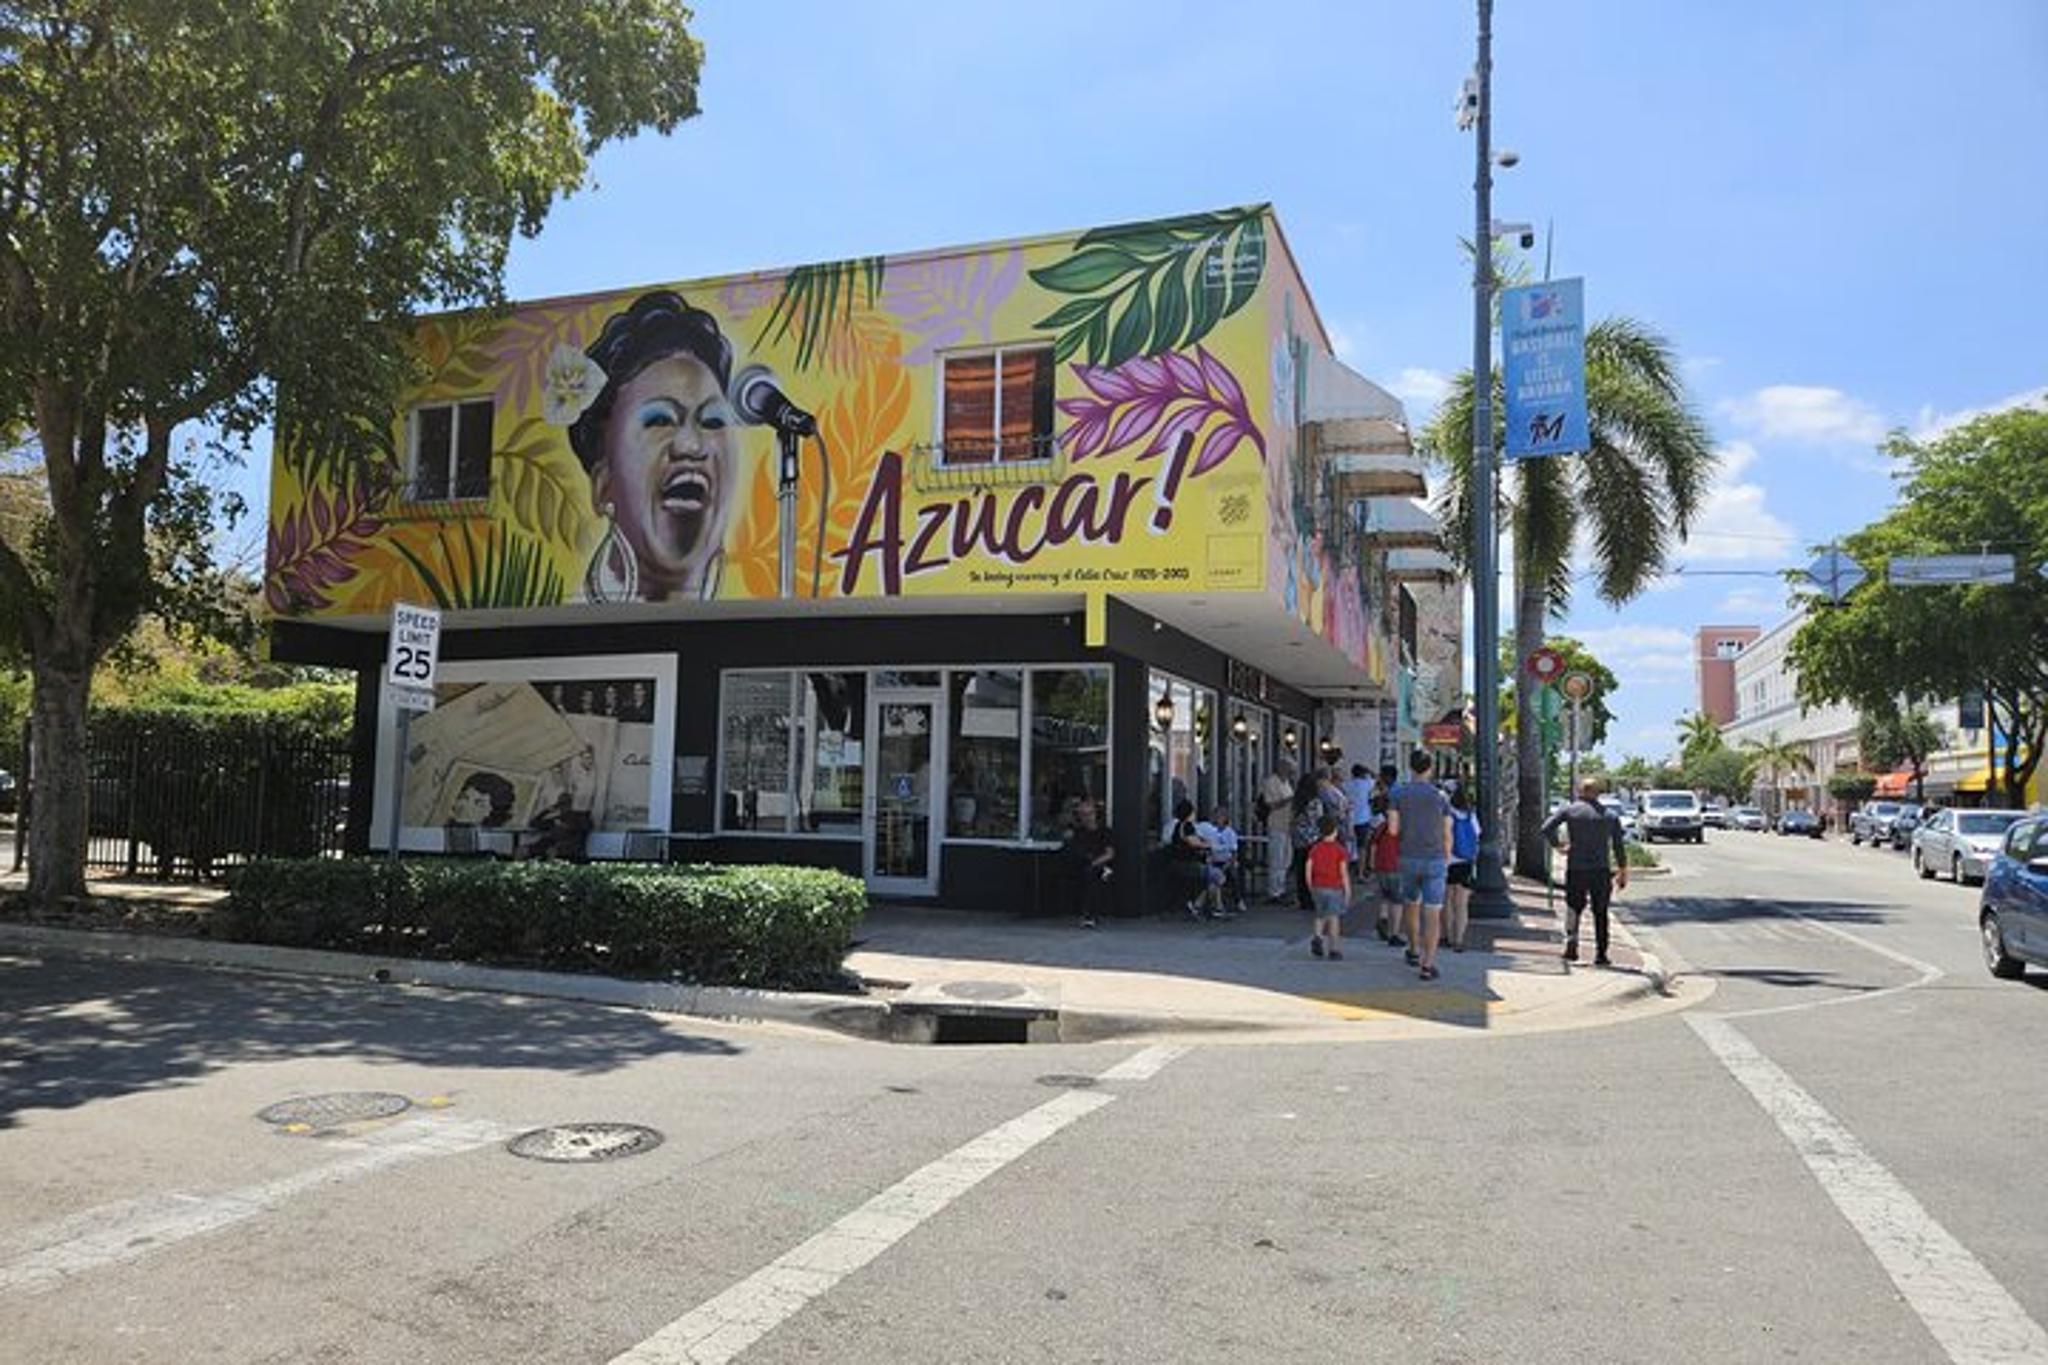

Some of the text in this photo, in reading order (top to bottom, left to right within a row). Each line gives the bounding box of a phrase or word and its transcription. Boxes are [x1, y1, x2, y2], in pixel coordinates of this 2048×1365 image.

[1075, 567, 1099, 581] Celia
[397, 610, 437, 631] SPEED
[399, 628, 432, 645] LIMIT
[394, 646, 431, 680] 25
